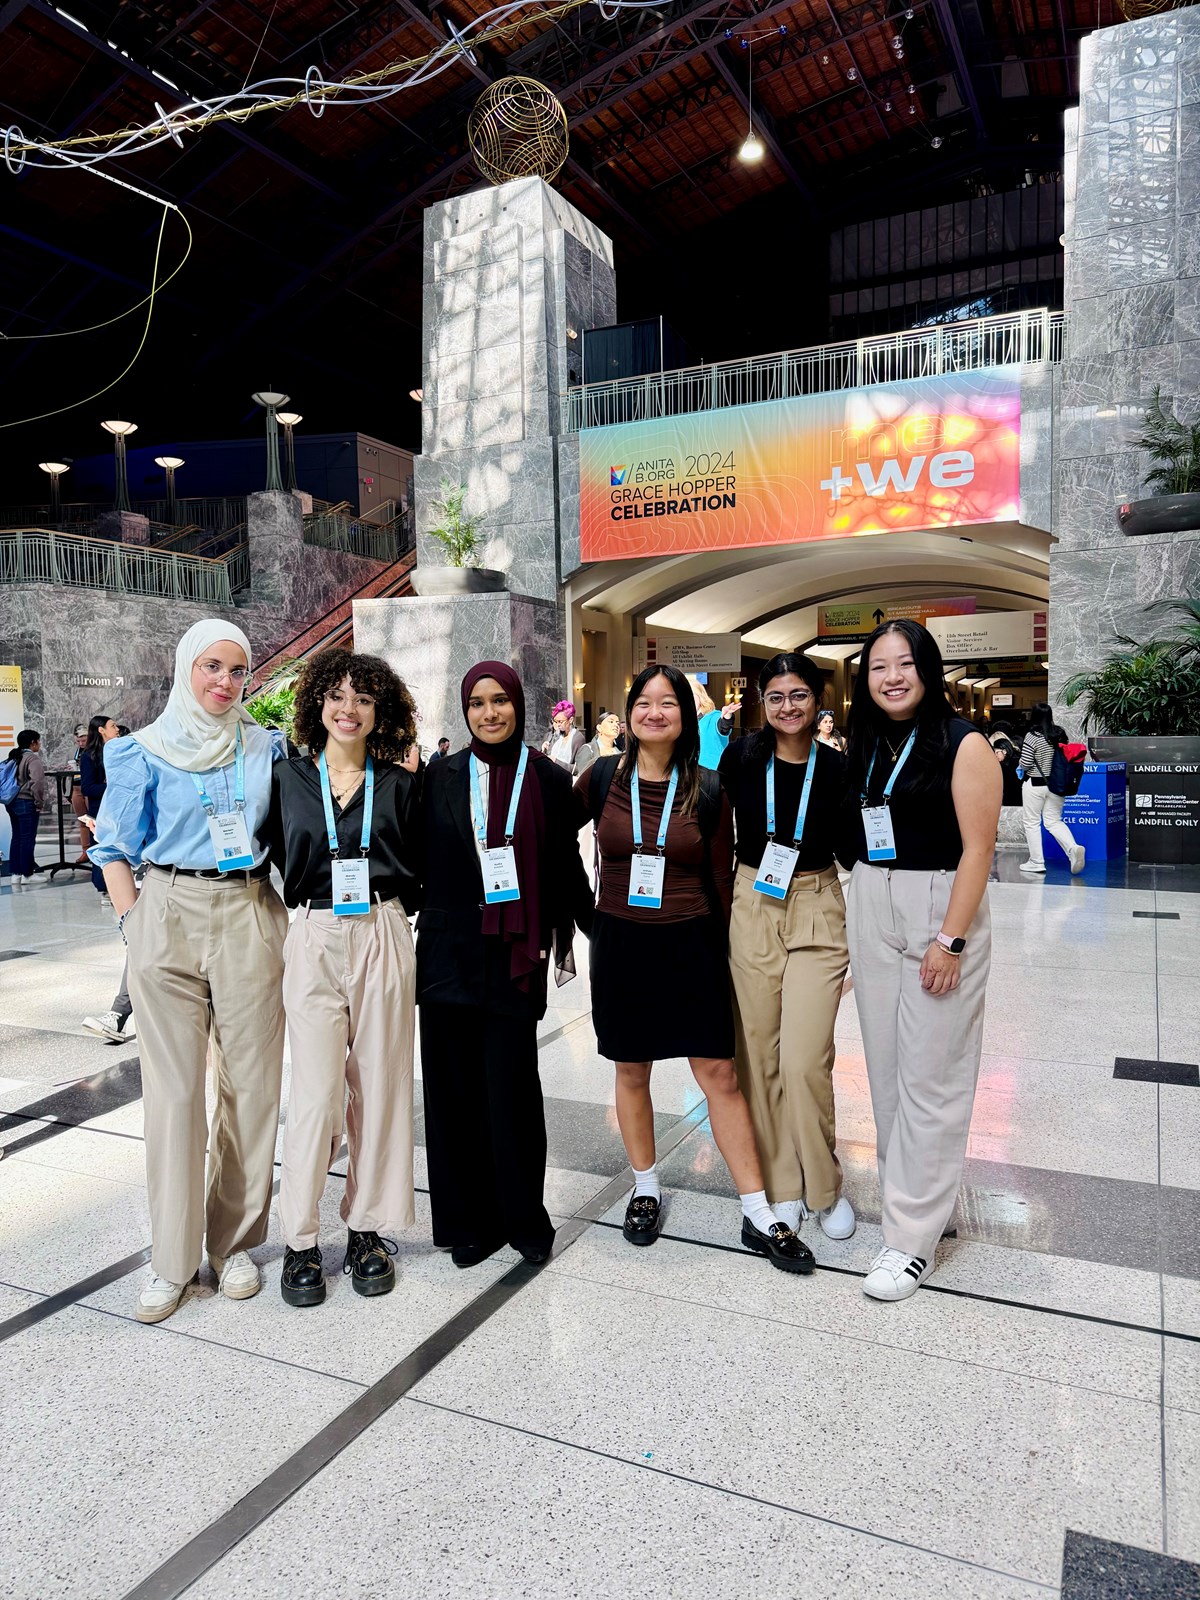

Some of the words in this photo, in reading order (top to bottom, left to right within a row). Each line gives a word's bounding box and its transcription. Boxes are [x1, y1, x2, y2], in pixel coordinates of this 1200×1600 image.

[830, 416, 946, 464] me
[636, 458, 675, 472] ANITA
[636, 469, 675, 483] B.ORG
[686, 450, 736, 477] 2024
[610, 485, 663, 504] GRACE
[669, 476, 736, 497] HOPPER
[611, 493, 735, 521] CELEBRATION
